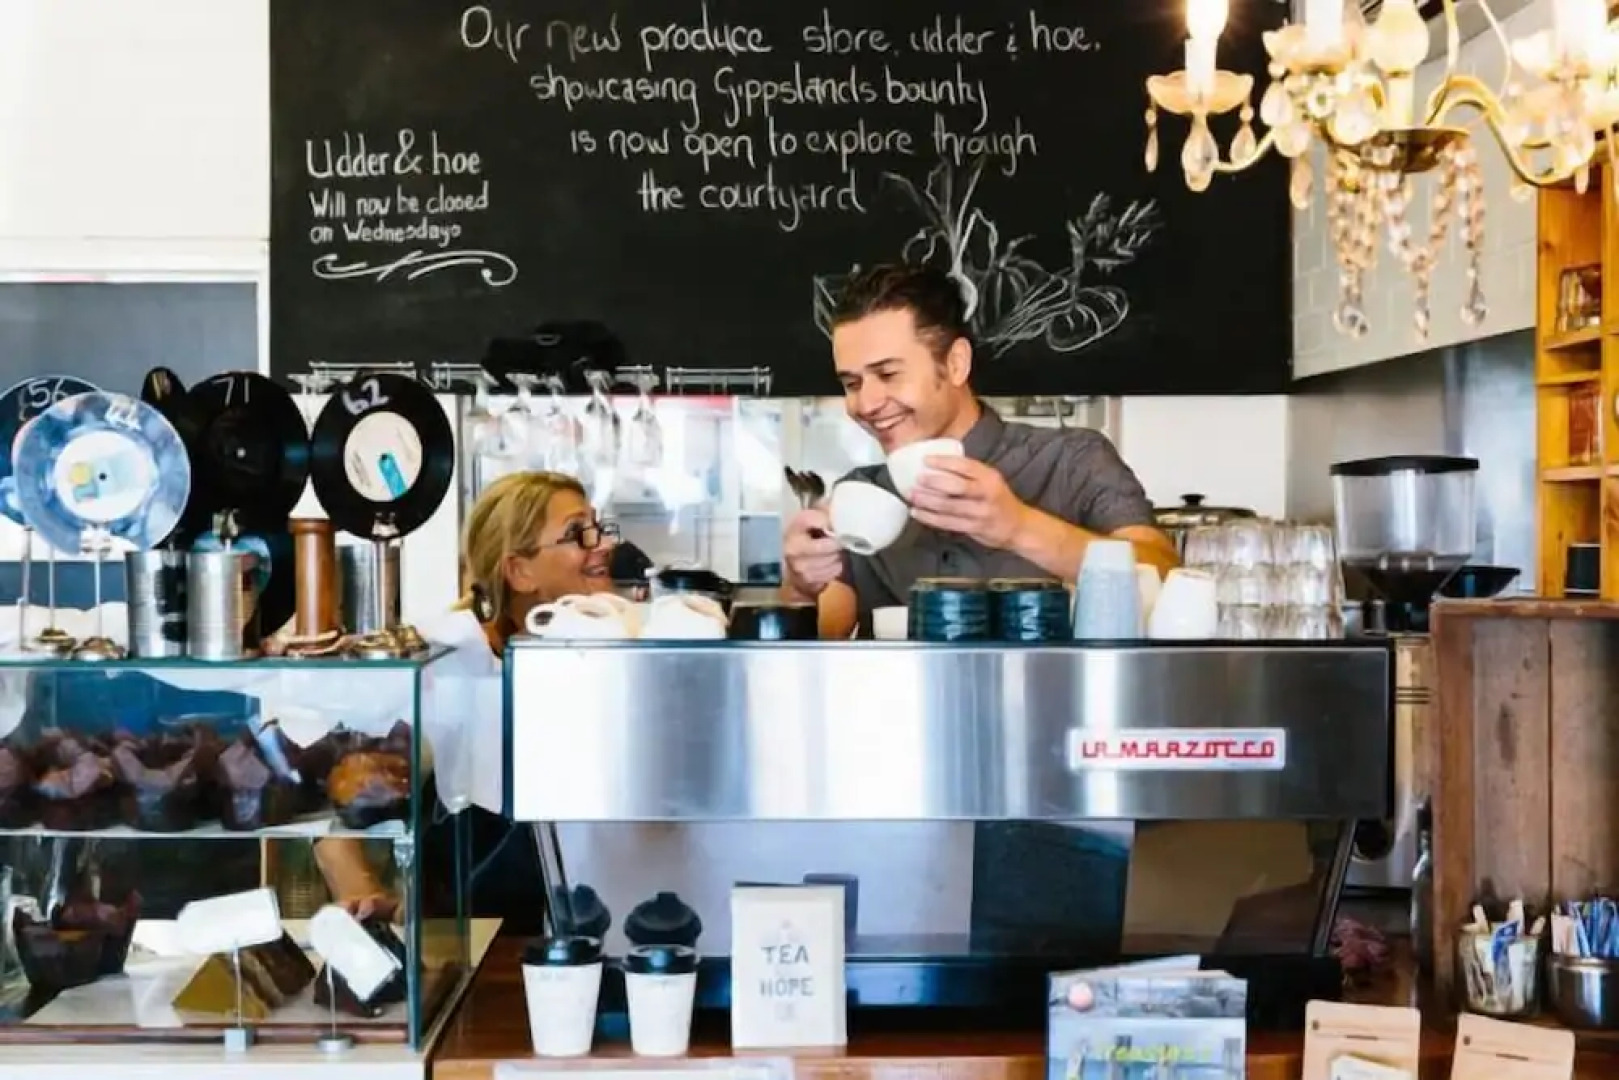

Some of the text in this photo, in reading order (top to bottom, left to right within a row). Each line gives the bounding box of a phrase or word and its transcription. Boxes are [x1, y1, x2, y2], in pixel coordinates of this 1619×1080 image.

[461, 5, 530, 63] Our
[547, 12, 621, 63] new
[640, 2, 772, 72] produce
[910, 13, 995, 54] udder
[530, 61, 988, 133] showcasing Gippslands bounty
[305, 128, 481, 178] Udder & hoe
[570, 112, 1037, 177] is now open to explore through
[309, 179, 490, 218] Will now be closed
[637, 162, 868, 232] the courtyard
[310, 216, 462, 248] on Wednesdays
[211, 376, 250, 406] 71
[1082, 741, 1108, 758] LA
[760, 943, 809, 964] TEA
